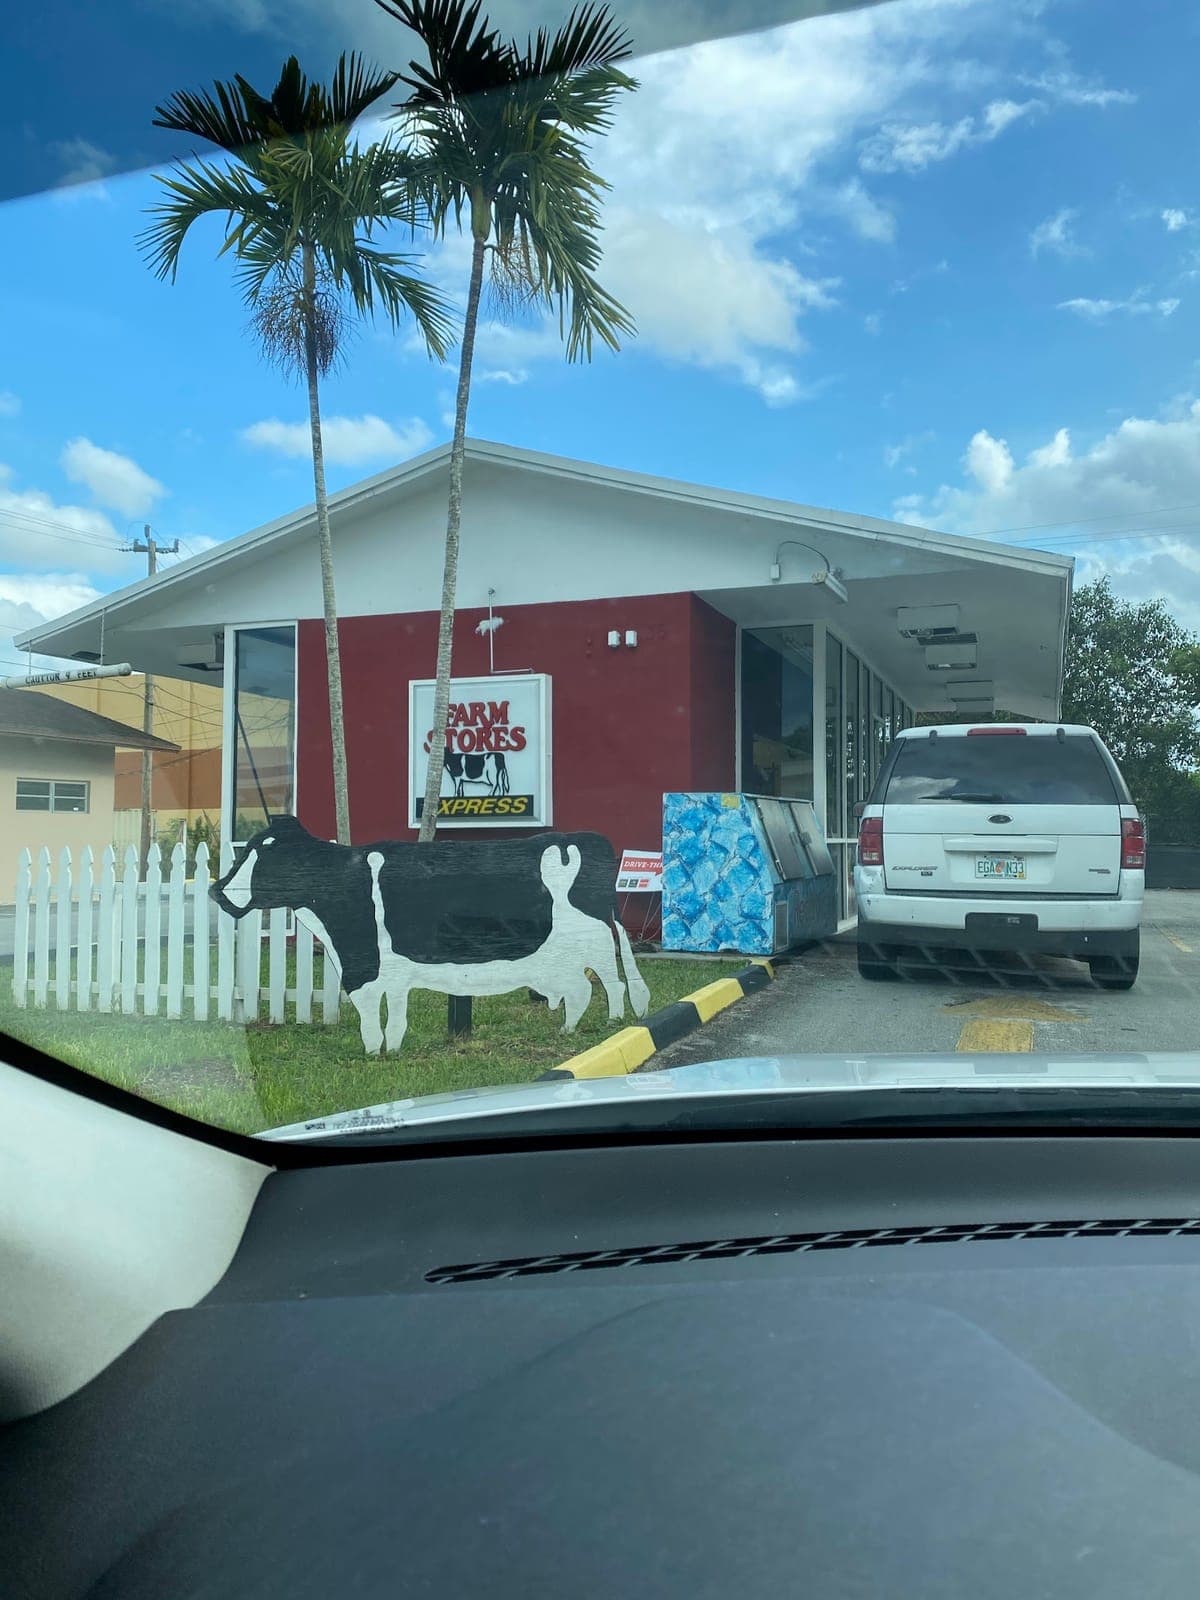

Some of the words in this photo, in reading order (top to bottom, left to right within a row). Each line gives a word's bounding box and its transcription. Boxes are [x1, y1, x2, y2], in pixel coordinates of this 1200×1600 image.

[26, 673, 60, 684] CAUTION
[437, 797, 529, 815] XPRESS
[978, 861, 995, 873] EGA
